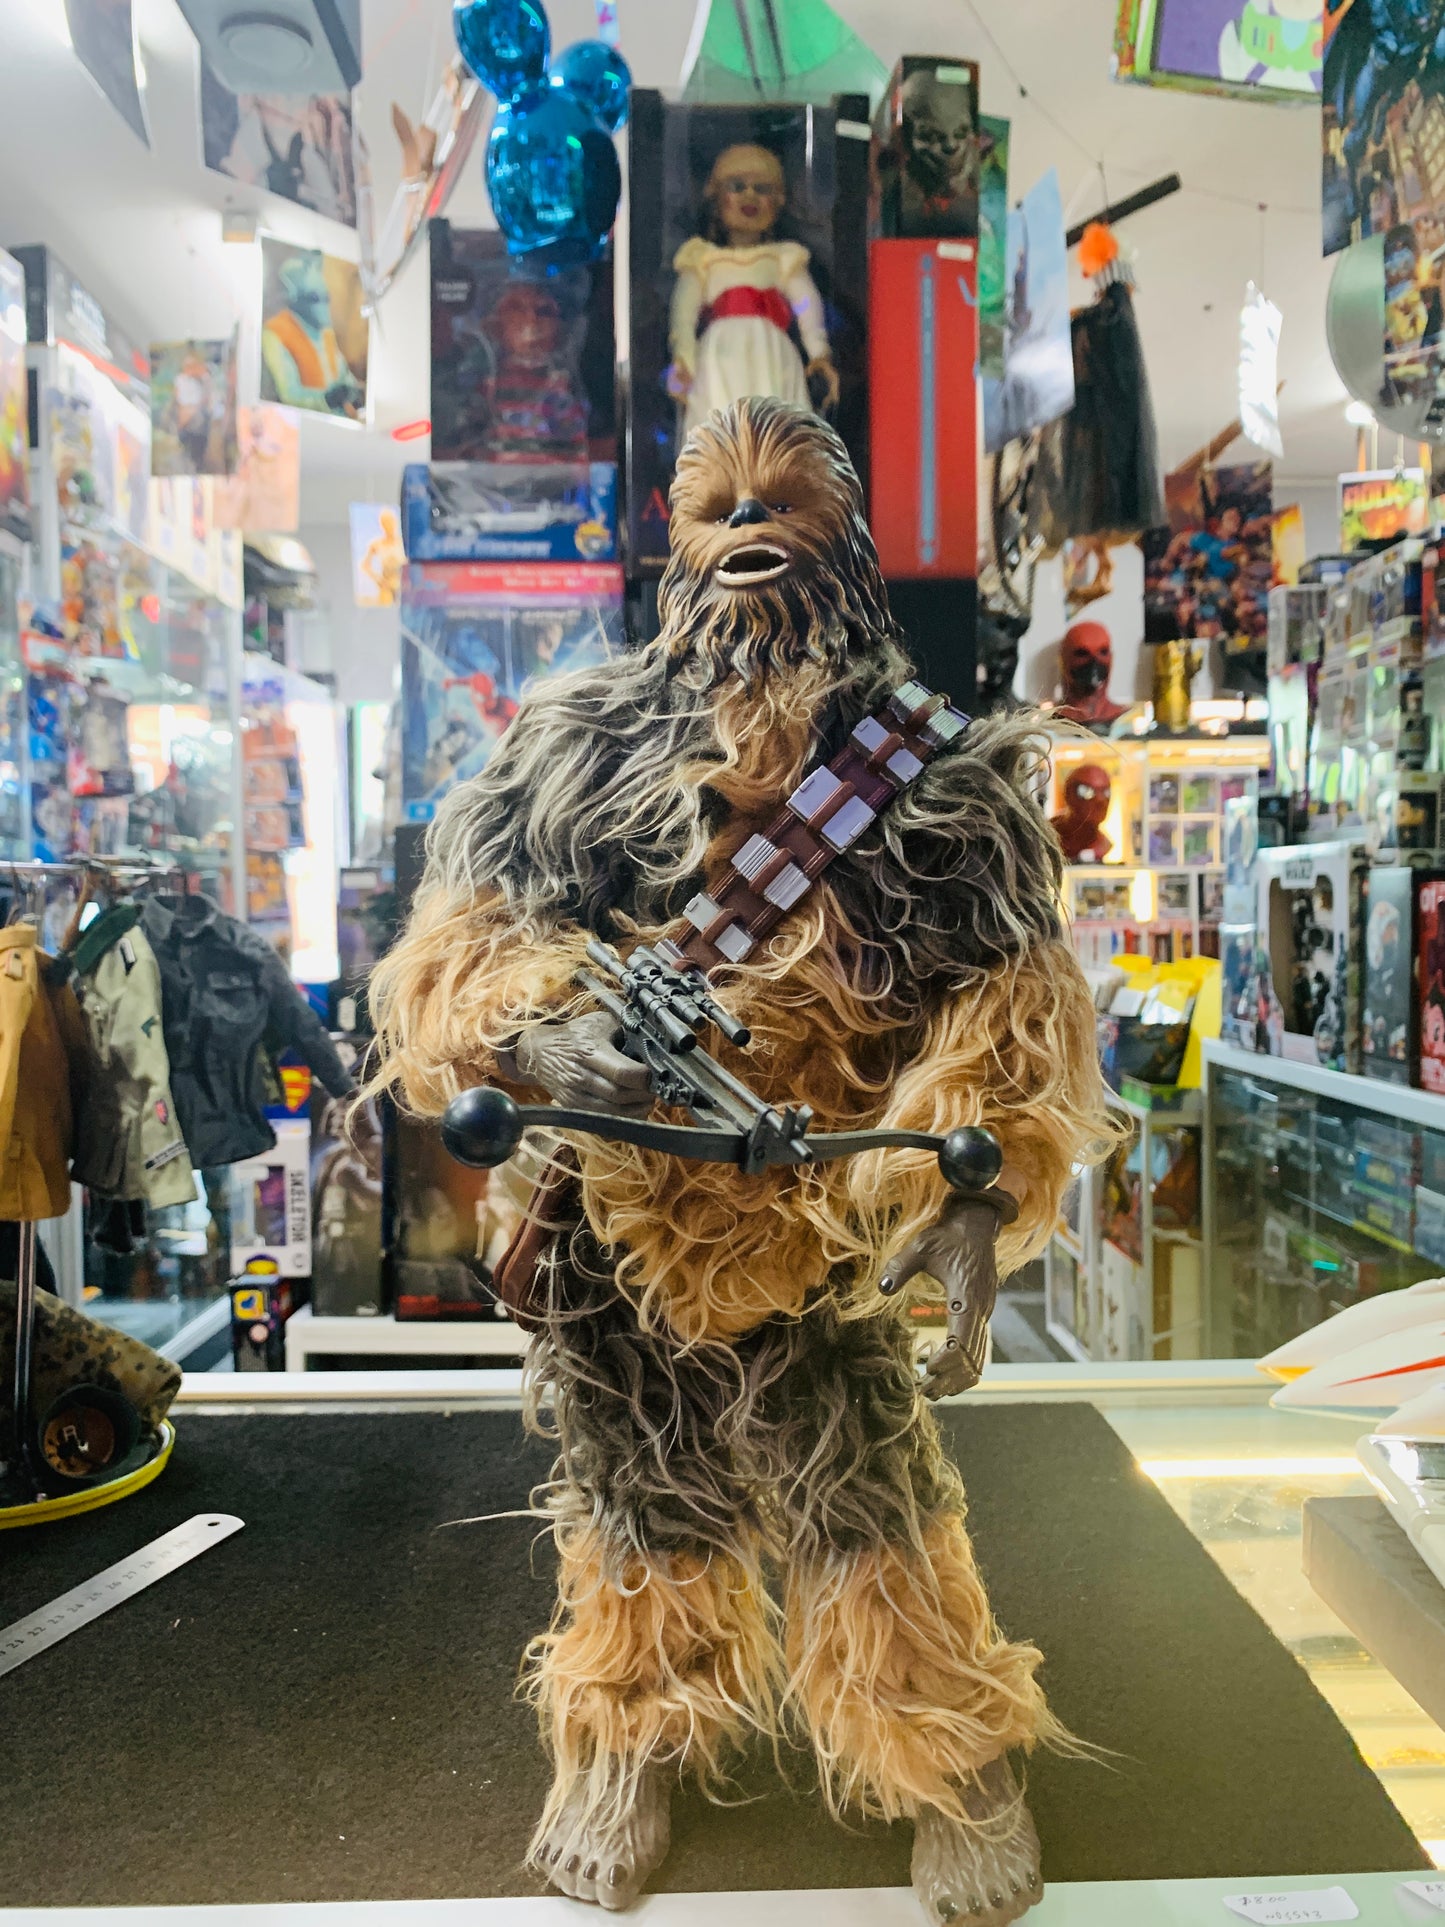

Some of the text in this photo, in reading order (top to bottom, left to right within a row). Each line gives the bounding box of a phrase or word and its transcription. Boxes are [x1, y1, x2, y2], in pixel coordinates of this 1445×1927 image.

[290, 1169, 306, 1243] SKELETOR
[26, 1626, 47, 1637] 22
[47, 1614, 65, 1625] 23
[66, 1603, 85, 1613] 24
[121, 1570, 137, 1580] 27
